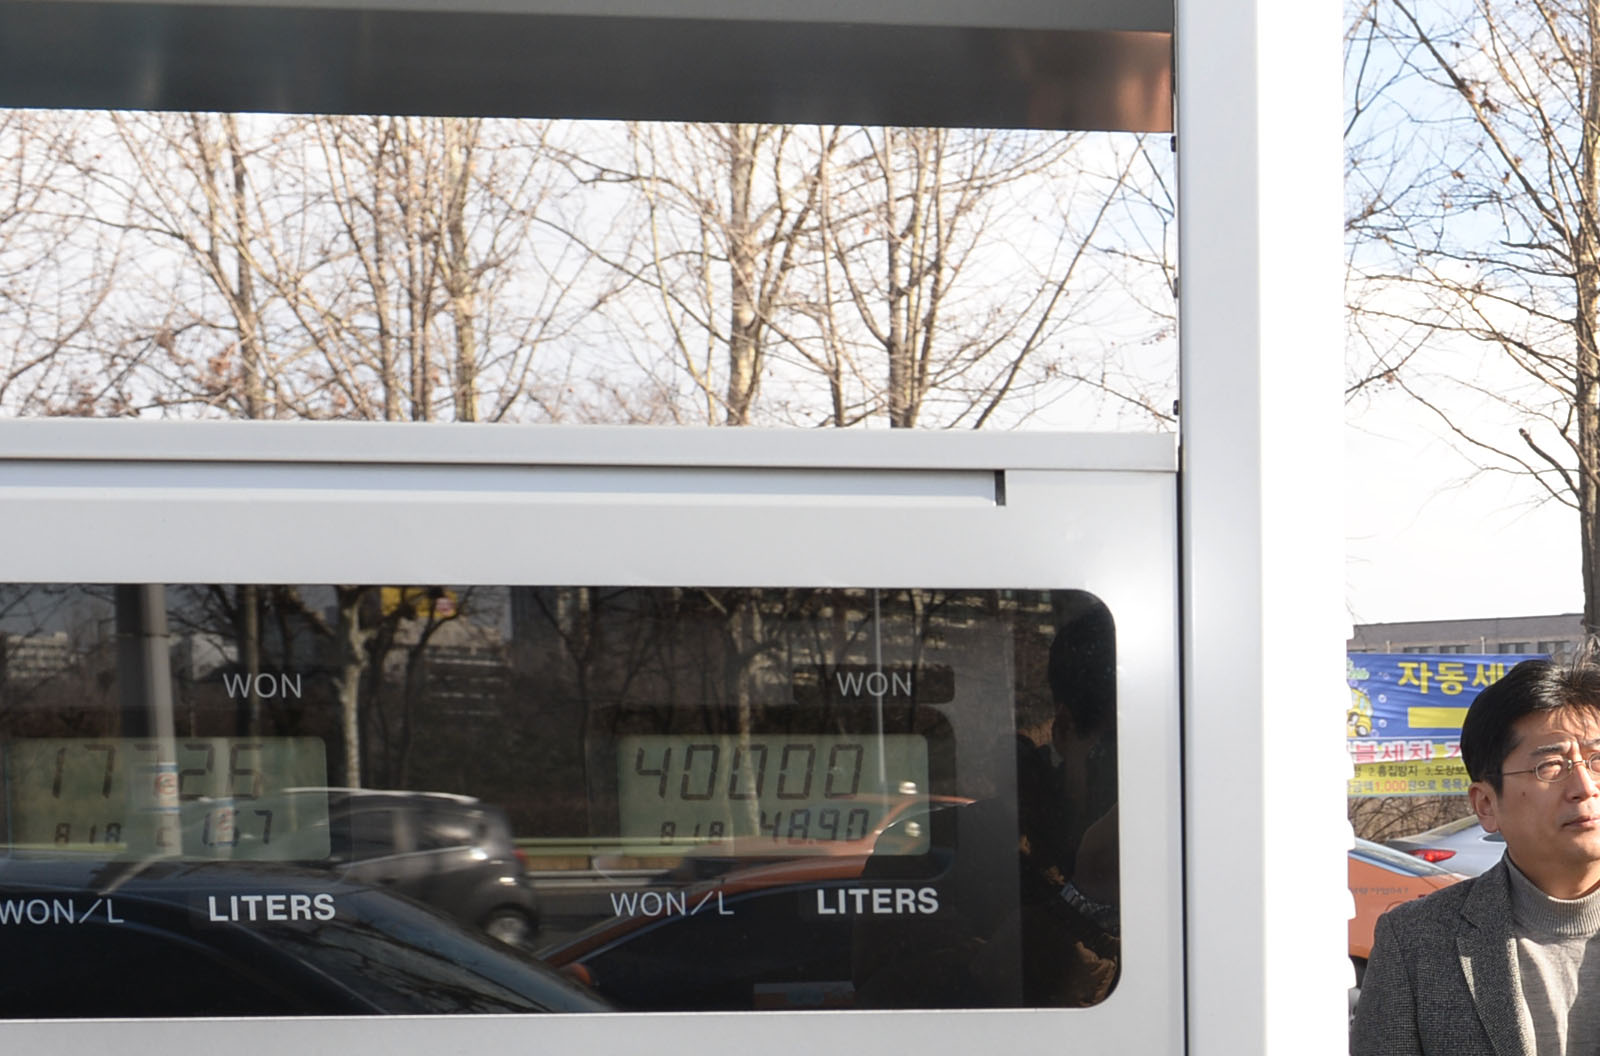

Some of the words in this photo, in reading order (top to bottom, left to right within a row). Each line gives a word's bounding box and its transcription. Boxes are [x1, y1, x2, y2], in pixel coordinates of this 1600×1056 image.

[223, 673, 301, 699] WON
[835, 671, 912, 698] WON
[1397, 661, 1514, 695] 자동세
[1347, 743, 1433, 763] 블세차
[635, 743, 864, 801] 40000
[208, 893, 336, 922] LITERS
[611, 890, 735, 917] WON/L
[816, 887, 940, 915] LITERS
